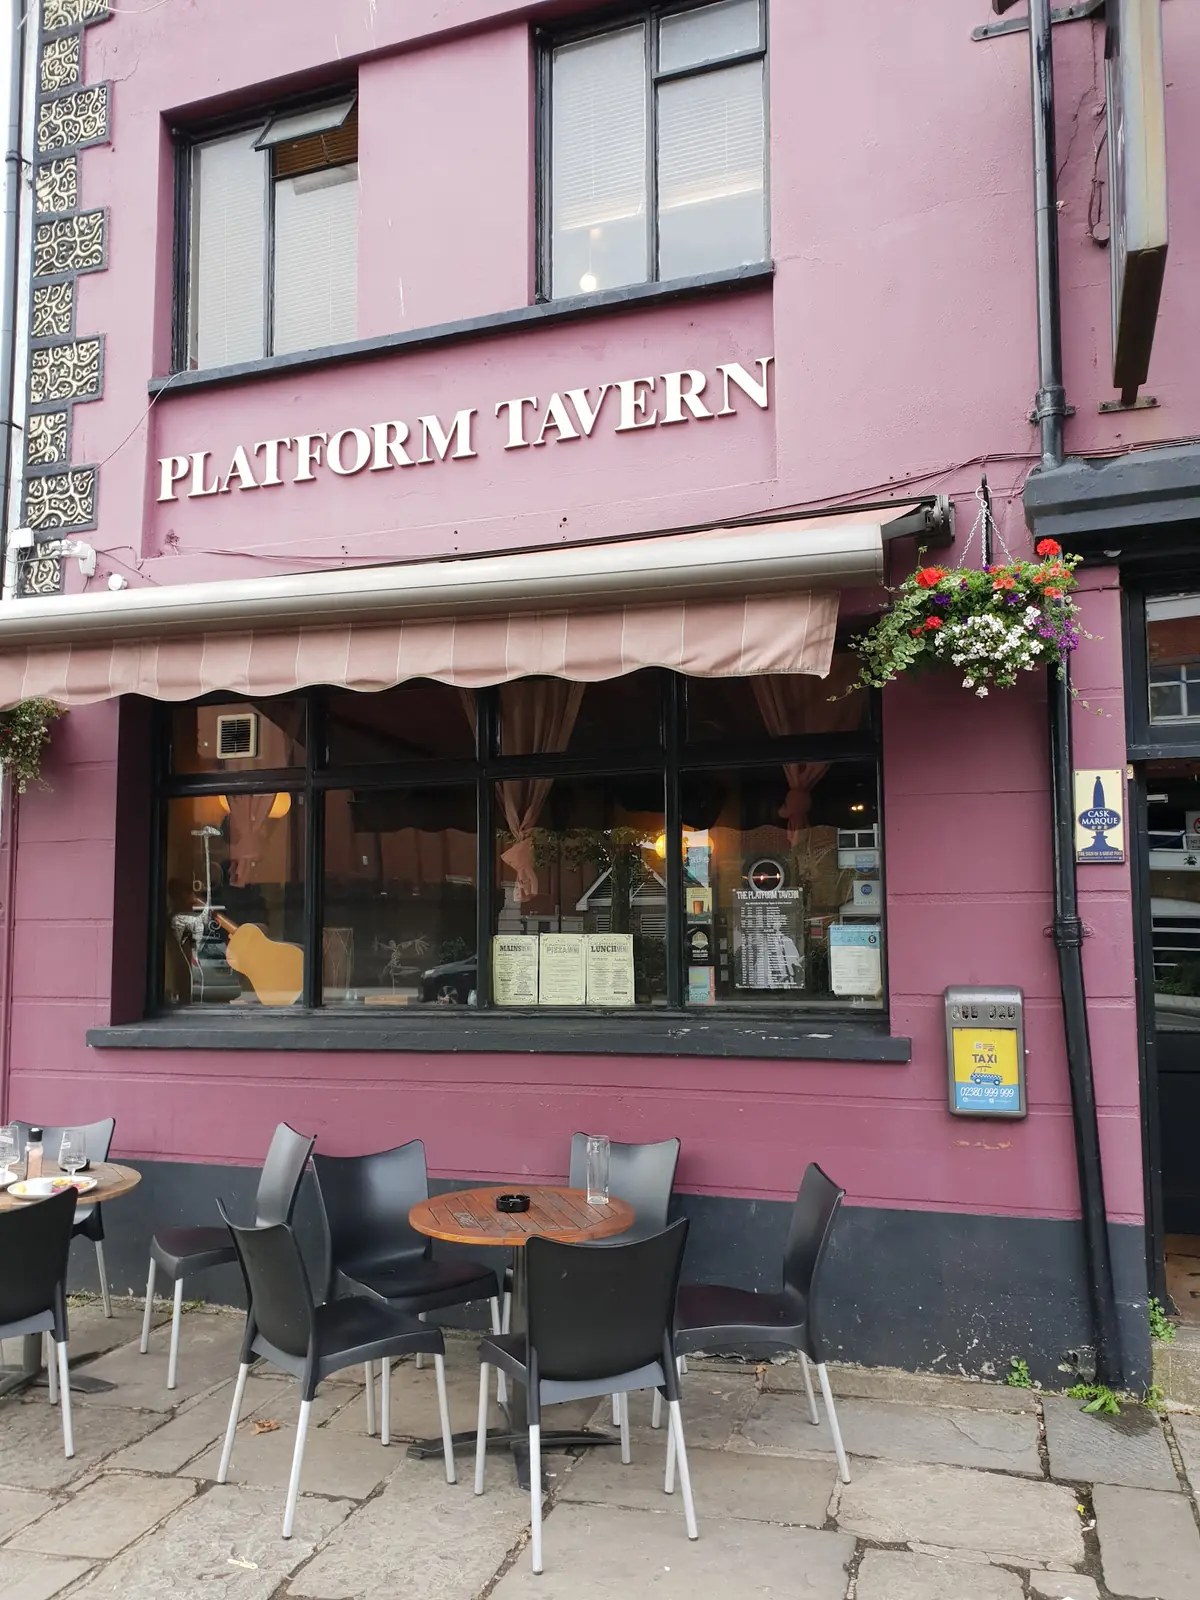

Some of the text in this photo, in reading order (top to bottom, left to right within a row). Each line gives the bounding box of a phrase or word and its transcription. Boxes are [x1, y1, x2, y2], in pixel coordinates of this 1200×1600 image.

[156, 355, 776, 503] PLATFORM TAVERN
[1087, 810, 1110, 818] CASK
[1081, 817, 1119, 826] MARQUE
[736, 890, 800, 900] THE PLATFORM TAVERN
[591, 945, 616, 953] LUNCH
[972, 1053, 998, 1064] TAXI
[960, 1086, 1015, 1098] 02380 999 999
